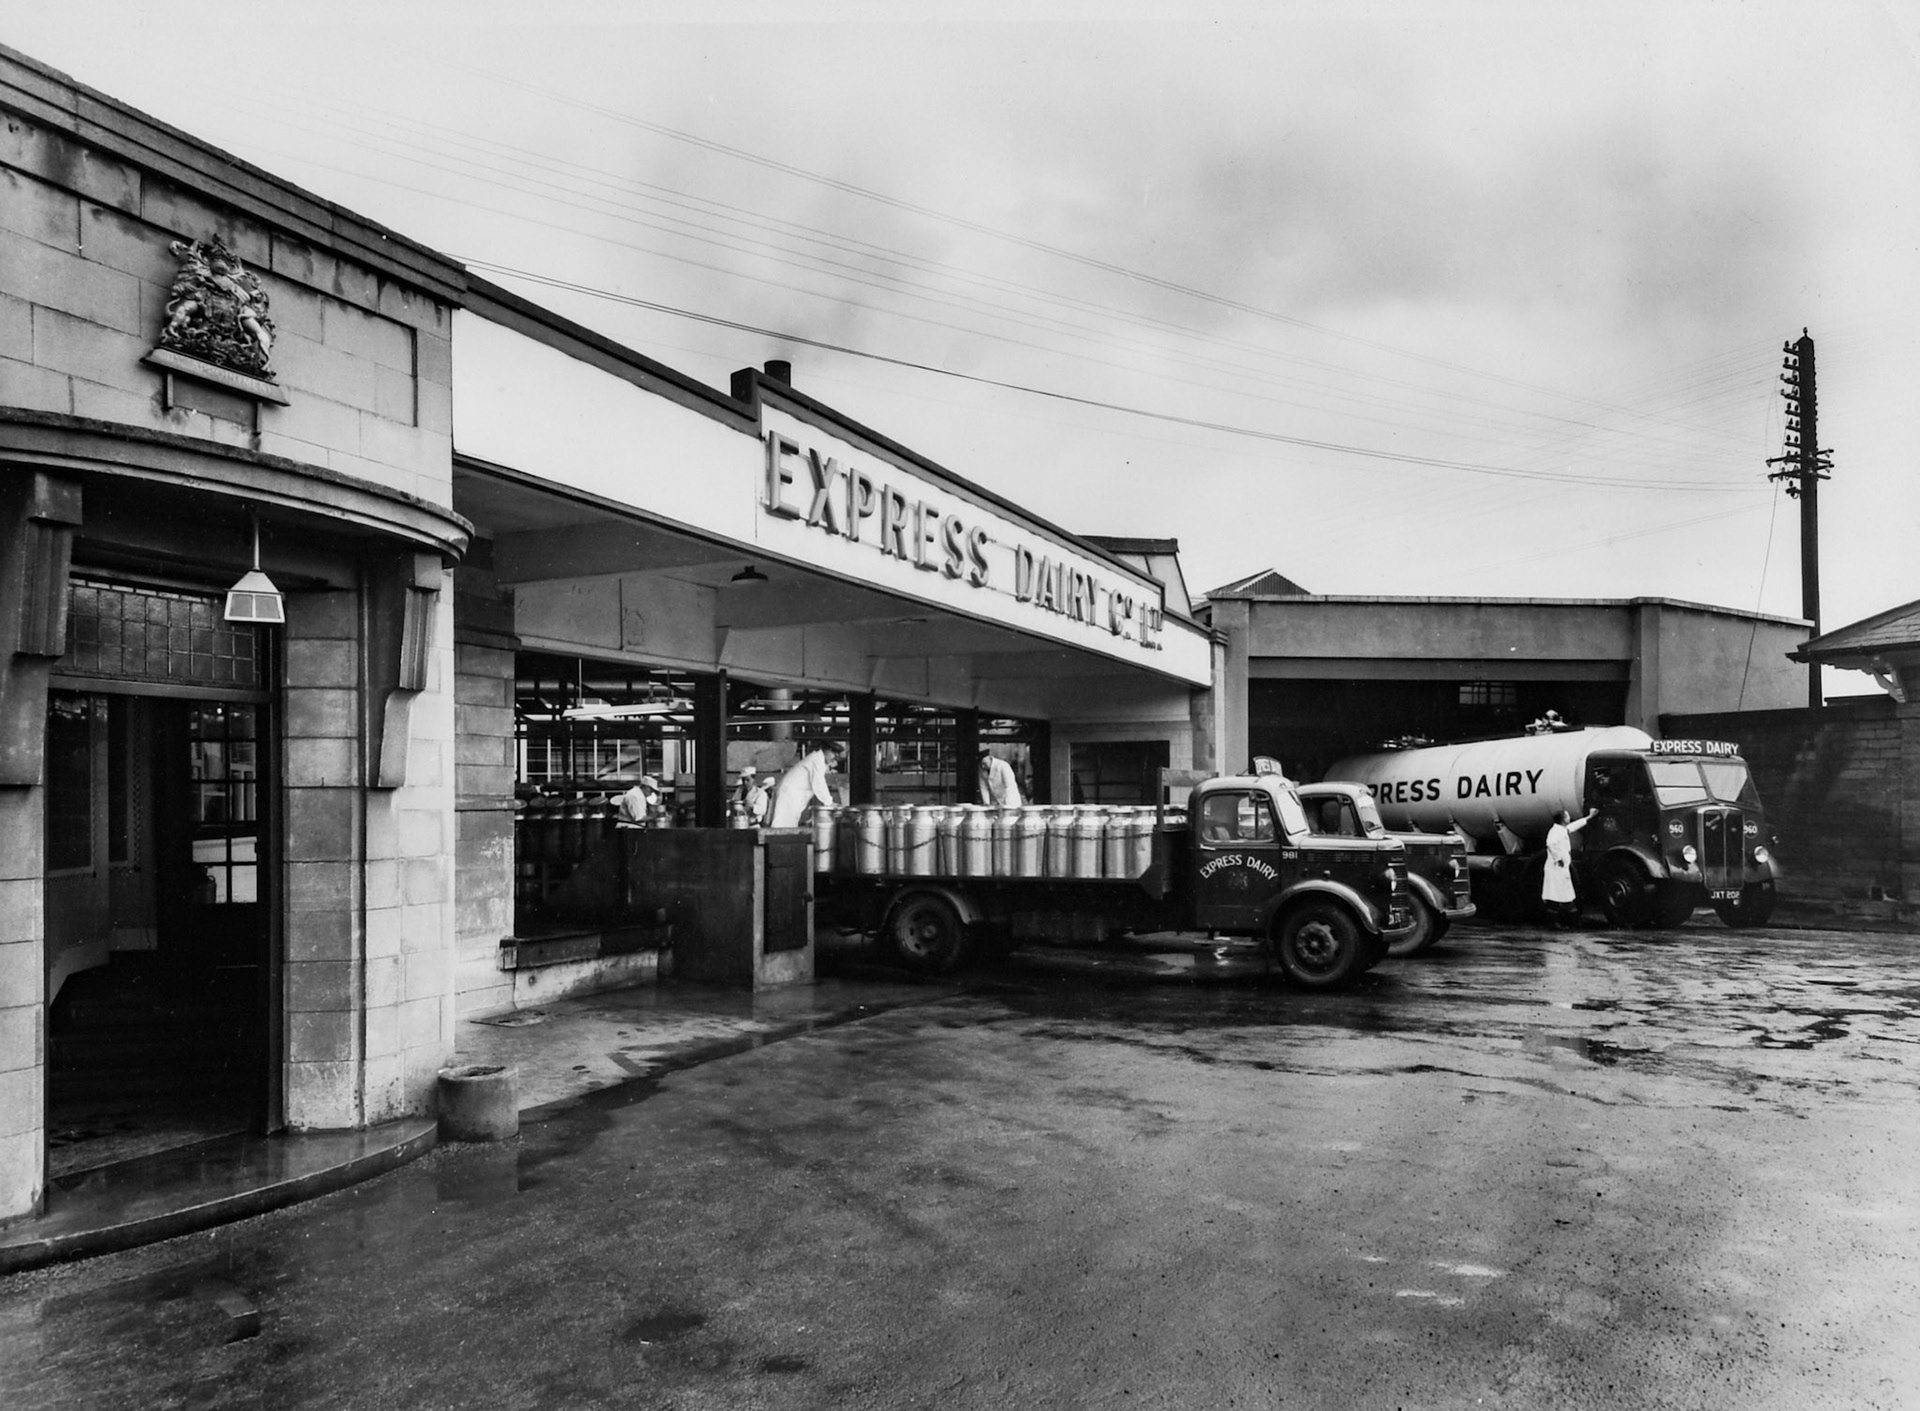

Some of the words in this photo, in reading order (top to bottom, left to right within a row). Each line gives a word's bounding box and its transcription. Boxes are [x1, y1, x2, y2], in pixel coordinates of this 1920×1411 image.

[765, 430, 990, 588] EXPRESS
[1015, 544, 1100, 626] DAIRY
[1653, 741, 1702, 754] EXPRESS
[1706, 741, 1739, 755] DAIRY
[1367, 778, 1441, 804] PRESS
[1457, 769, 1544, 799] DAIRY
[1669, 824, 1684, 834] 960
[1743, 825, 1758, 835] 960
[1282, 851, 1298, 859] 981
[1200, 854, 1243, 879] EXPRESS
[1246, 856, 1278, 880] DAIRY
